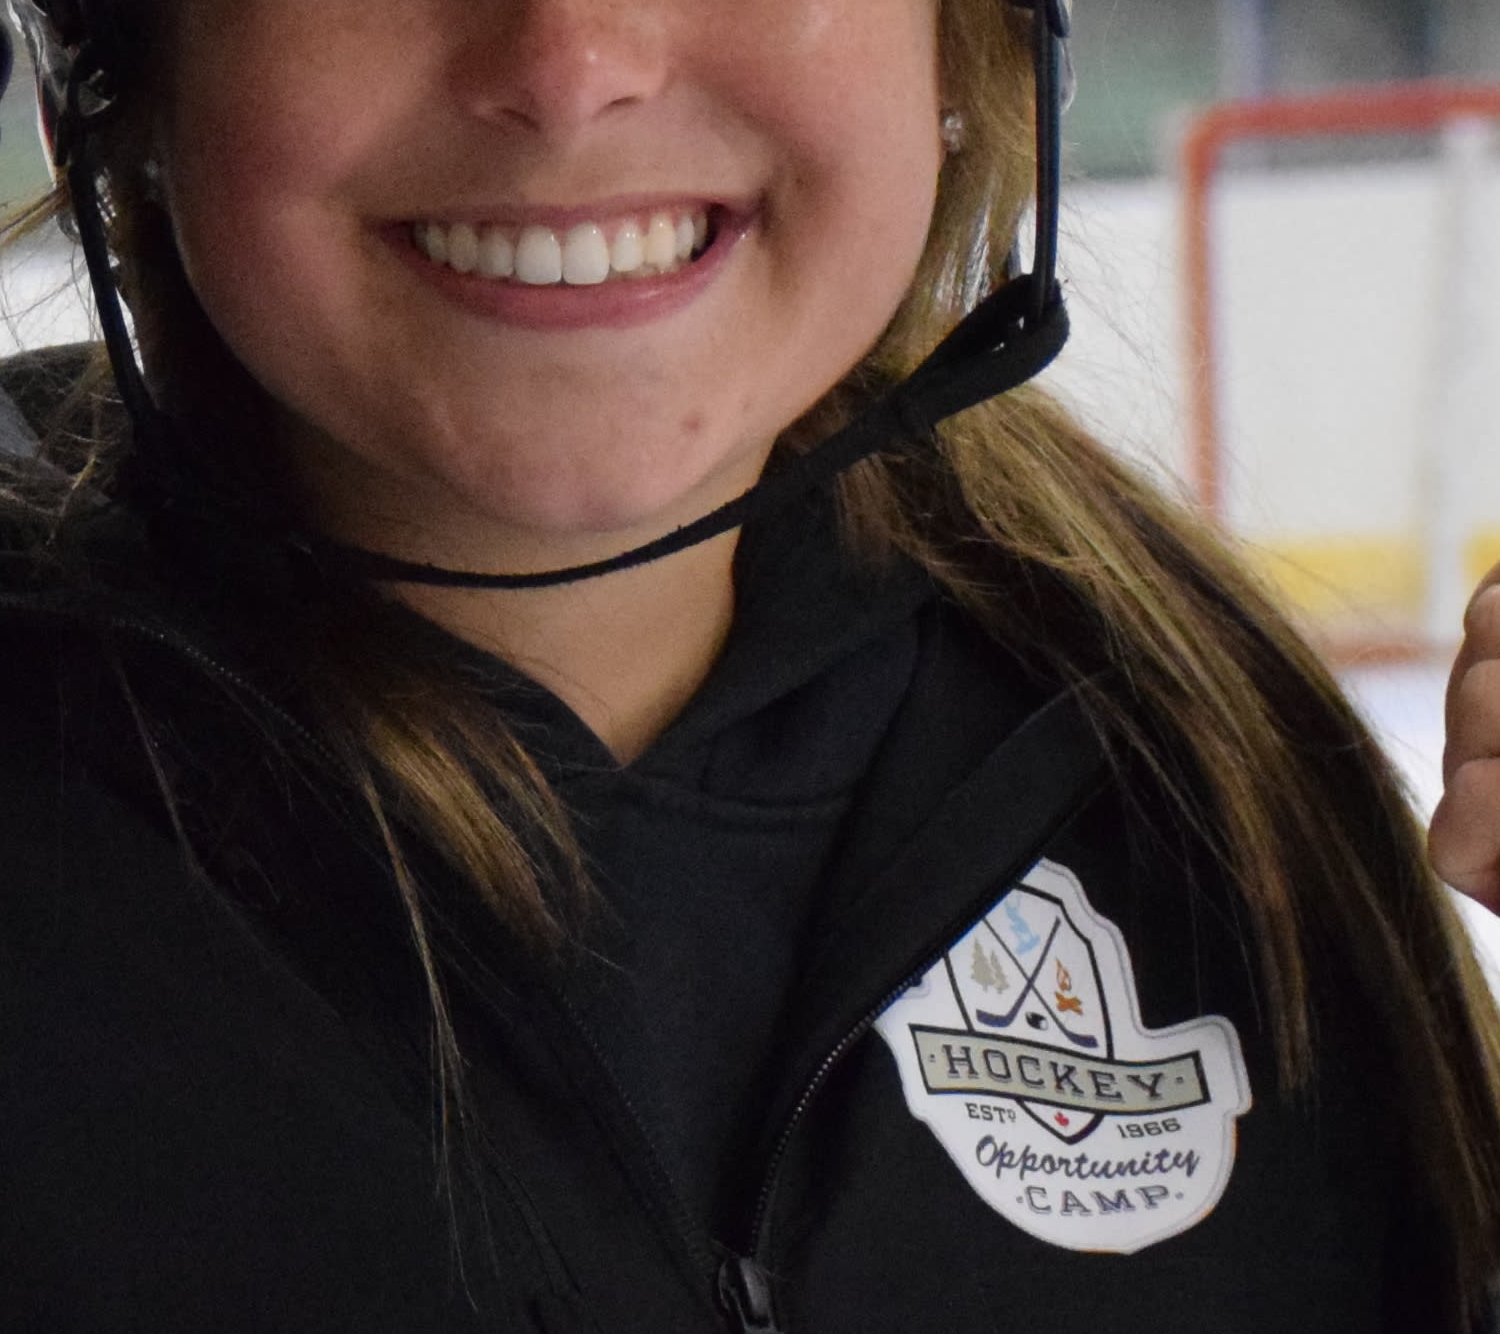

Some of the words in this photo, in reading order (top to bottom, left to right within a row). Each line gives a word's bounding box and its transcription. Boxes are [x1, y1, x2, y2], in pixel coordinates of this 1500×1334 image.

[941, 1044, 1168, 1103] HOCKEY
[1116, 1117, 1182, 1140] 1966
[975, 1134, 1202, 1181] Opportunity
[1025, 1184, 1173, 1217] CAMP
